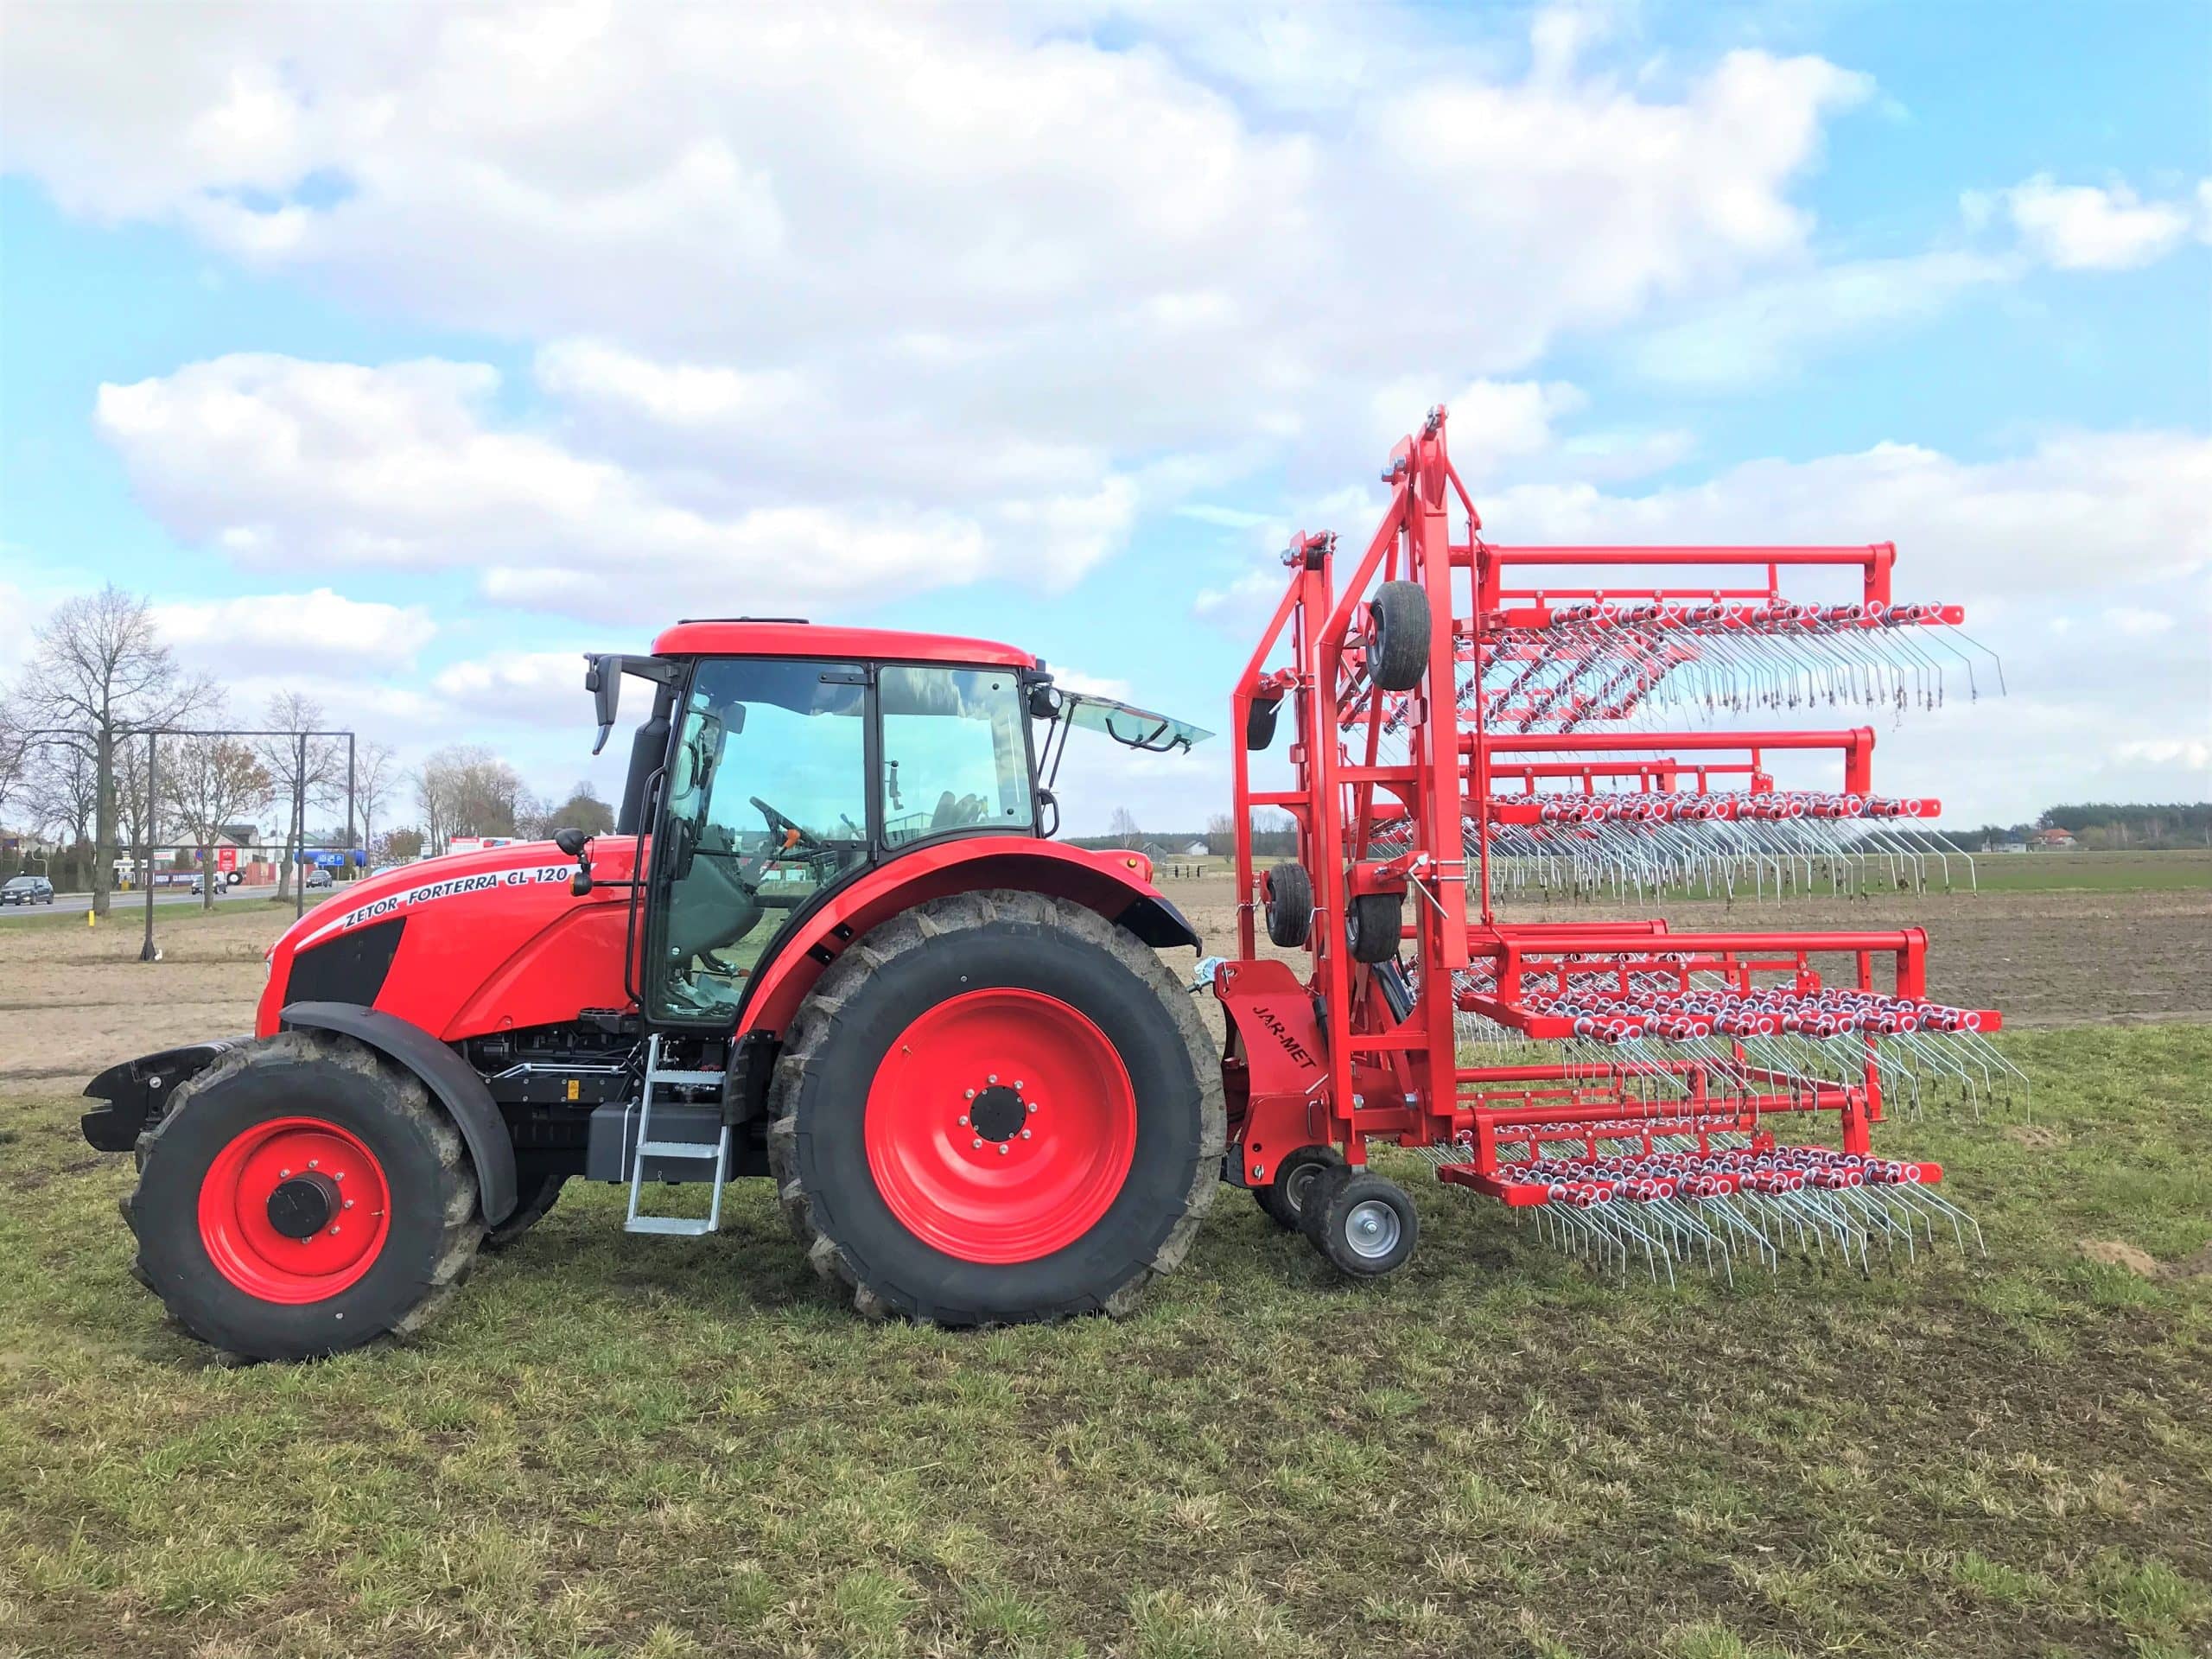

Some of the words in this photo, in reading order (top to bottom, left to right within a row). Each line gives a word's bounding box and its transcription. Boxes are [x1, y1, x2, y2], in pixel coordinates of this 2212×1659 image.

[345, 897, 398, 928] ZETOR
[408, 874, 499, 905] FORTERRA
[506, 872, 527, 885] CL
[536, 867, 569, 882] 120
[1252, 1007, 1317, 1069] JAR-MET
